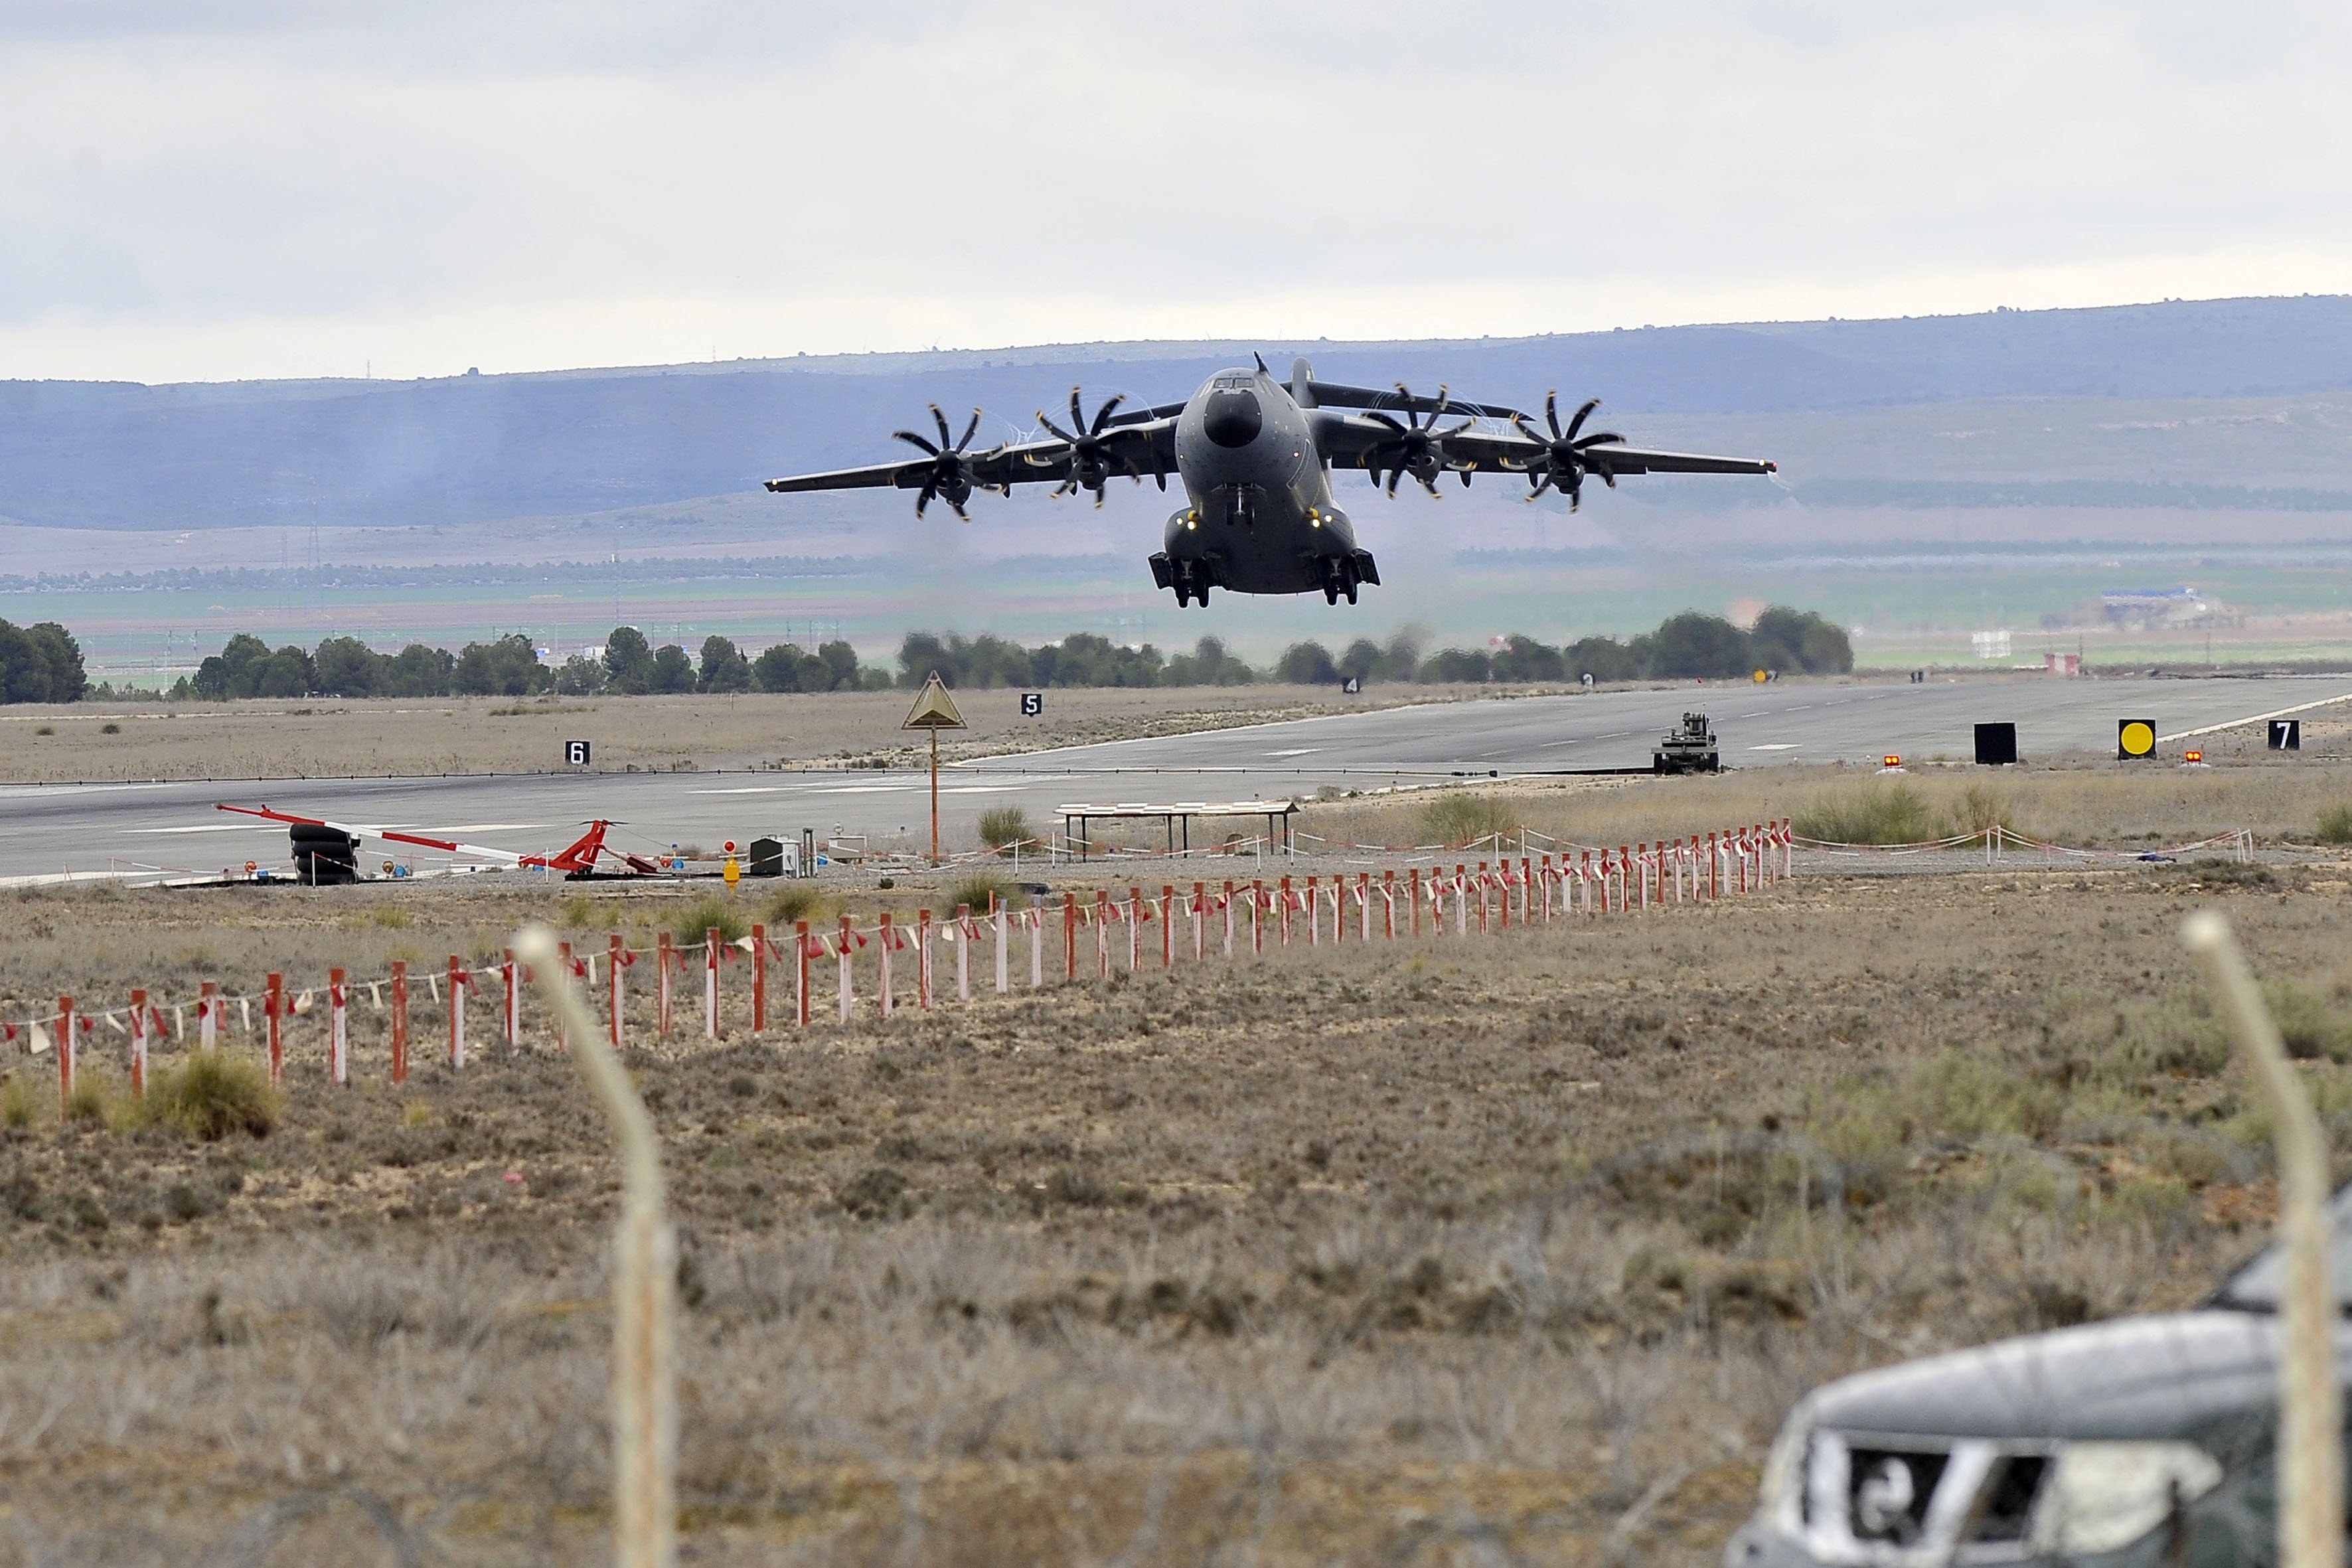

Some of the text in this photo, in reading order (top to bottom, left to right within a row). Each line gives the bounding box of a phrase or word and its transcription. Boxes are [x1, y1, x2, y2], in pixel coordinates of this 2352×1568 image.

[1026, 695, 1038, 713] 5
[2276, 722, 2291, 749] 7
[571, 743, 584, 764] 6
